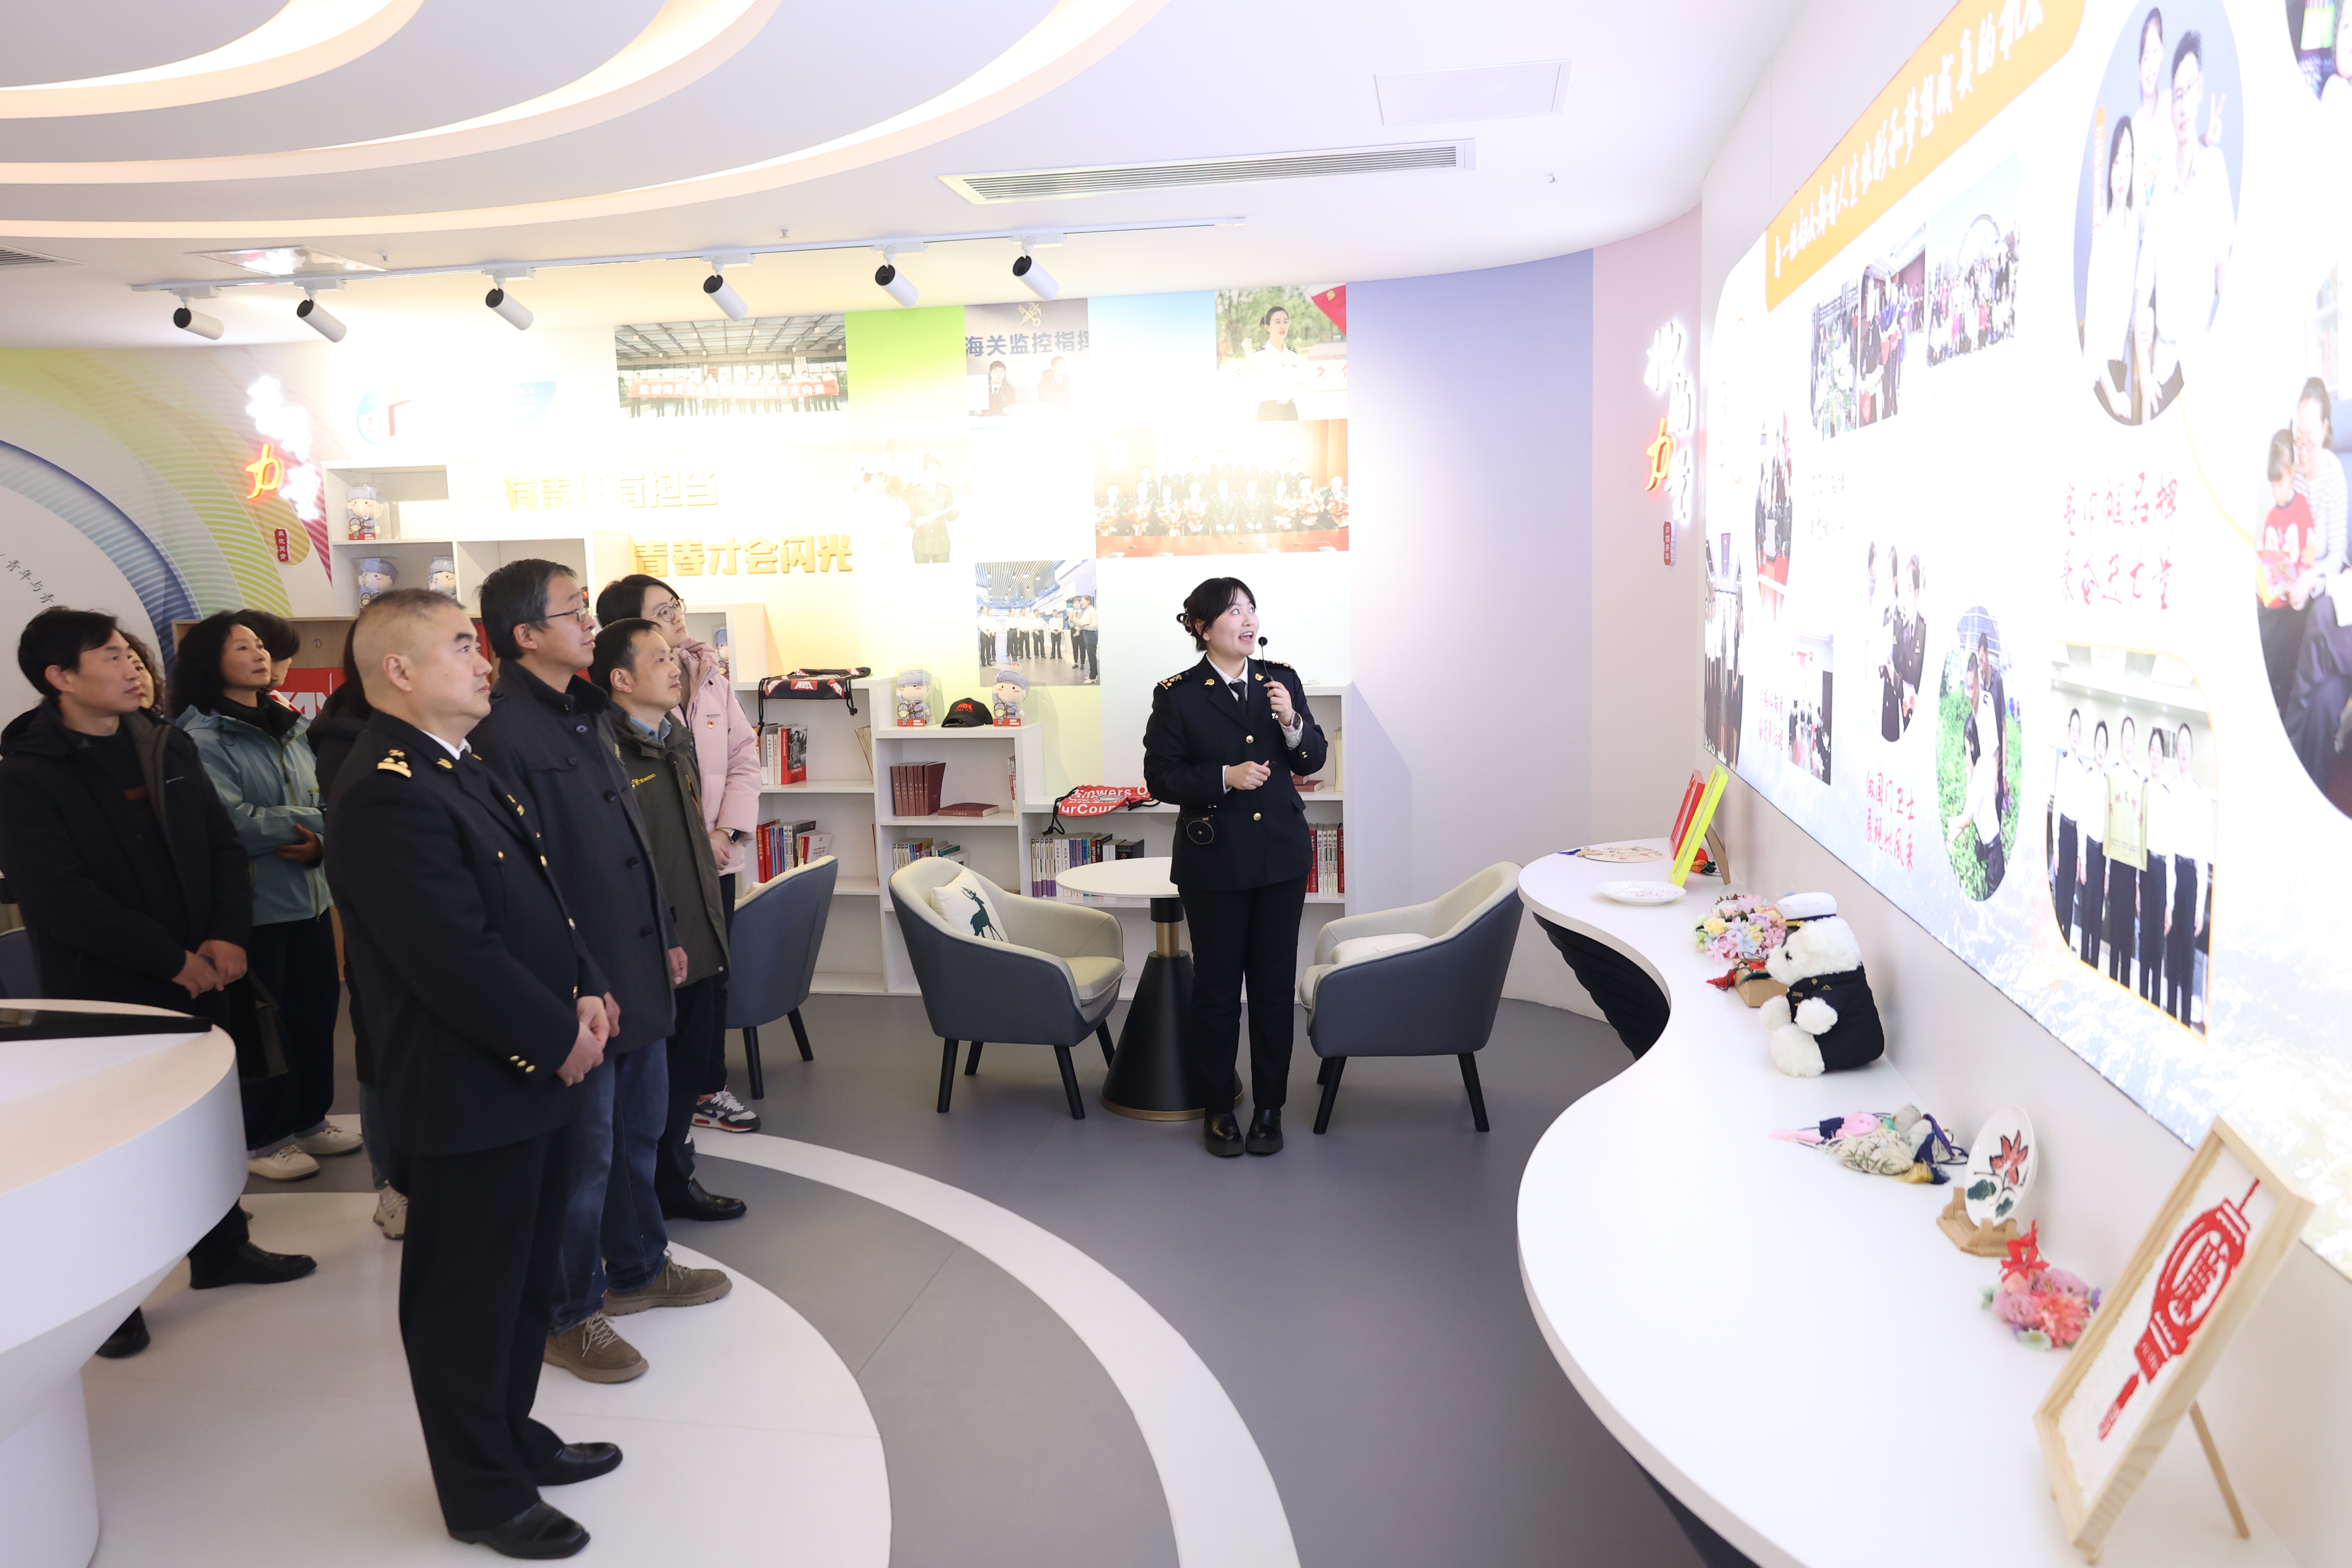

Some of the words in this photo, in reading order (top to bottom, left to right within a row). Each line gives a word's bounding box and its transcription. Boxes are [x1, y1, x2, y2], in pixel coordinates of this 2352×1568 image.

[0, 554, 55, 603] 青年与青
[635, 535, 853, 578] 青春才会闪光
